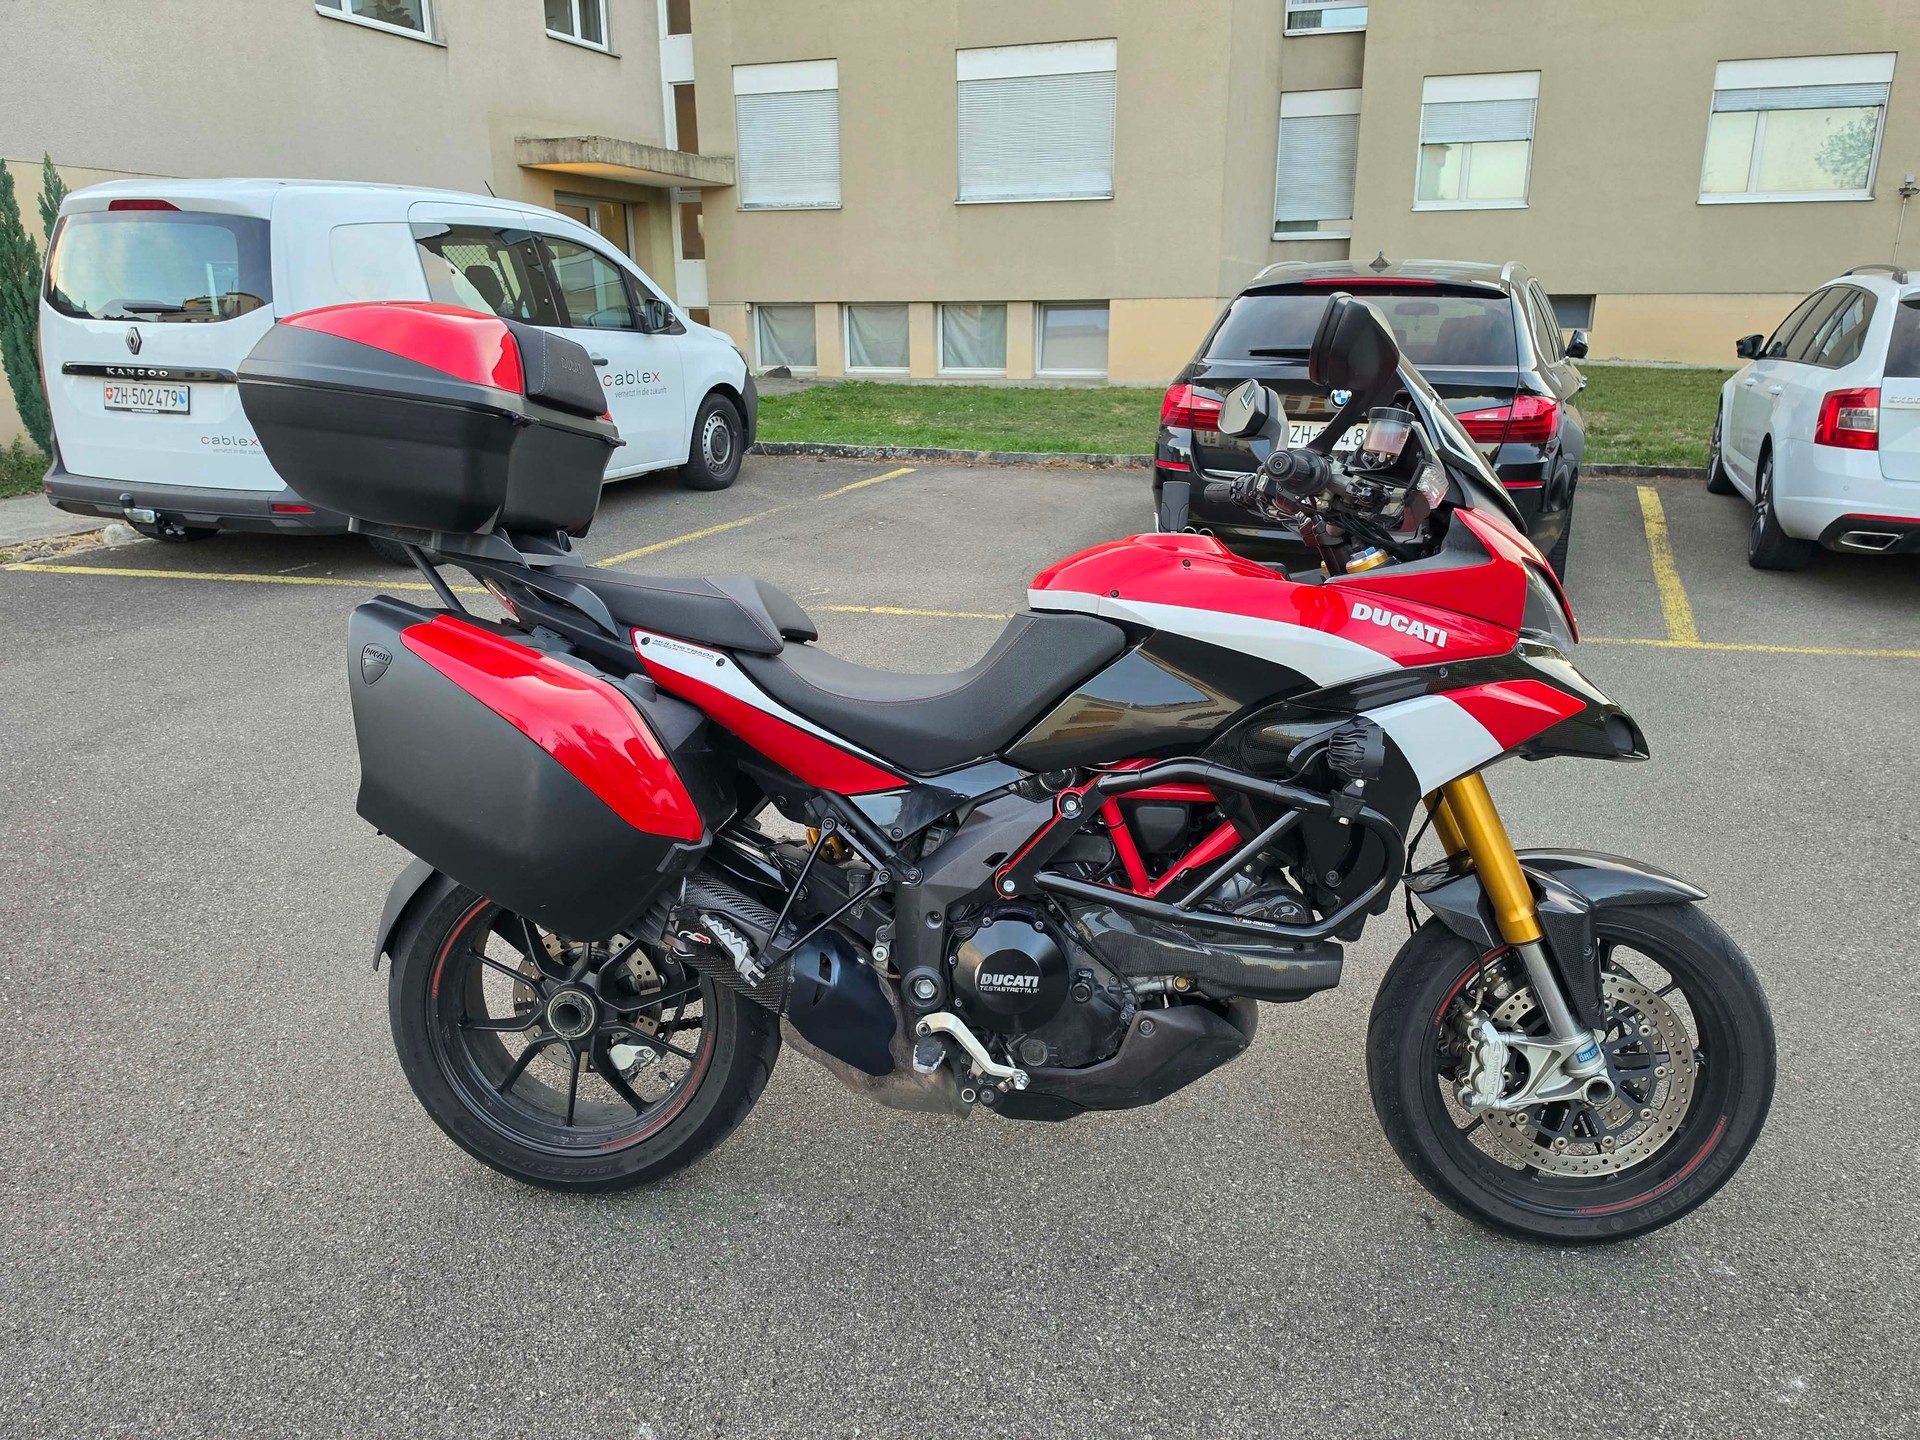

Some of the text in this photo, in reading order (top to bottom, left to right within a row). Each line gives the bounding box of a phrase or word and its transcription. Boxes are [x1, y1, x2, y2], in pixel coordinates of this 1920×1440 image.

[106, 367, 168, 377] KANGOO
[602, 370, 660, 387] cablex
[201, 436, 259, 446] cablex
[1351, 602, 1448, 648] DUCATI
[365, 647, 390, 661] DUCATI
[980, 973, 1040, 987] DUCATI
[980, 985, 1032, 993] TESTASTRETTA
